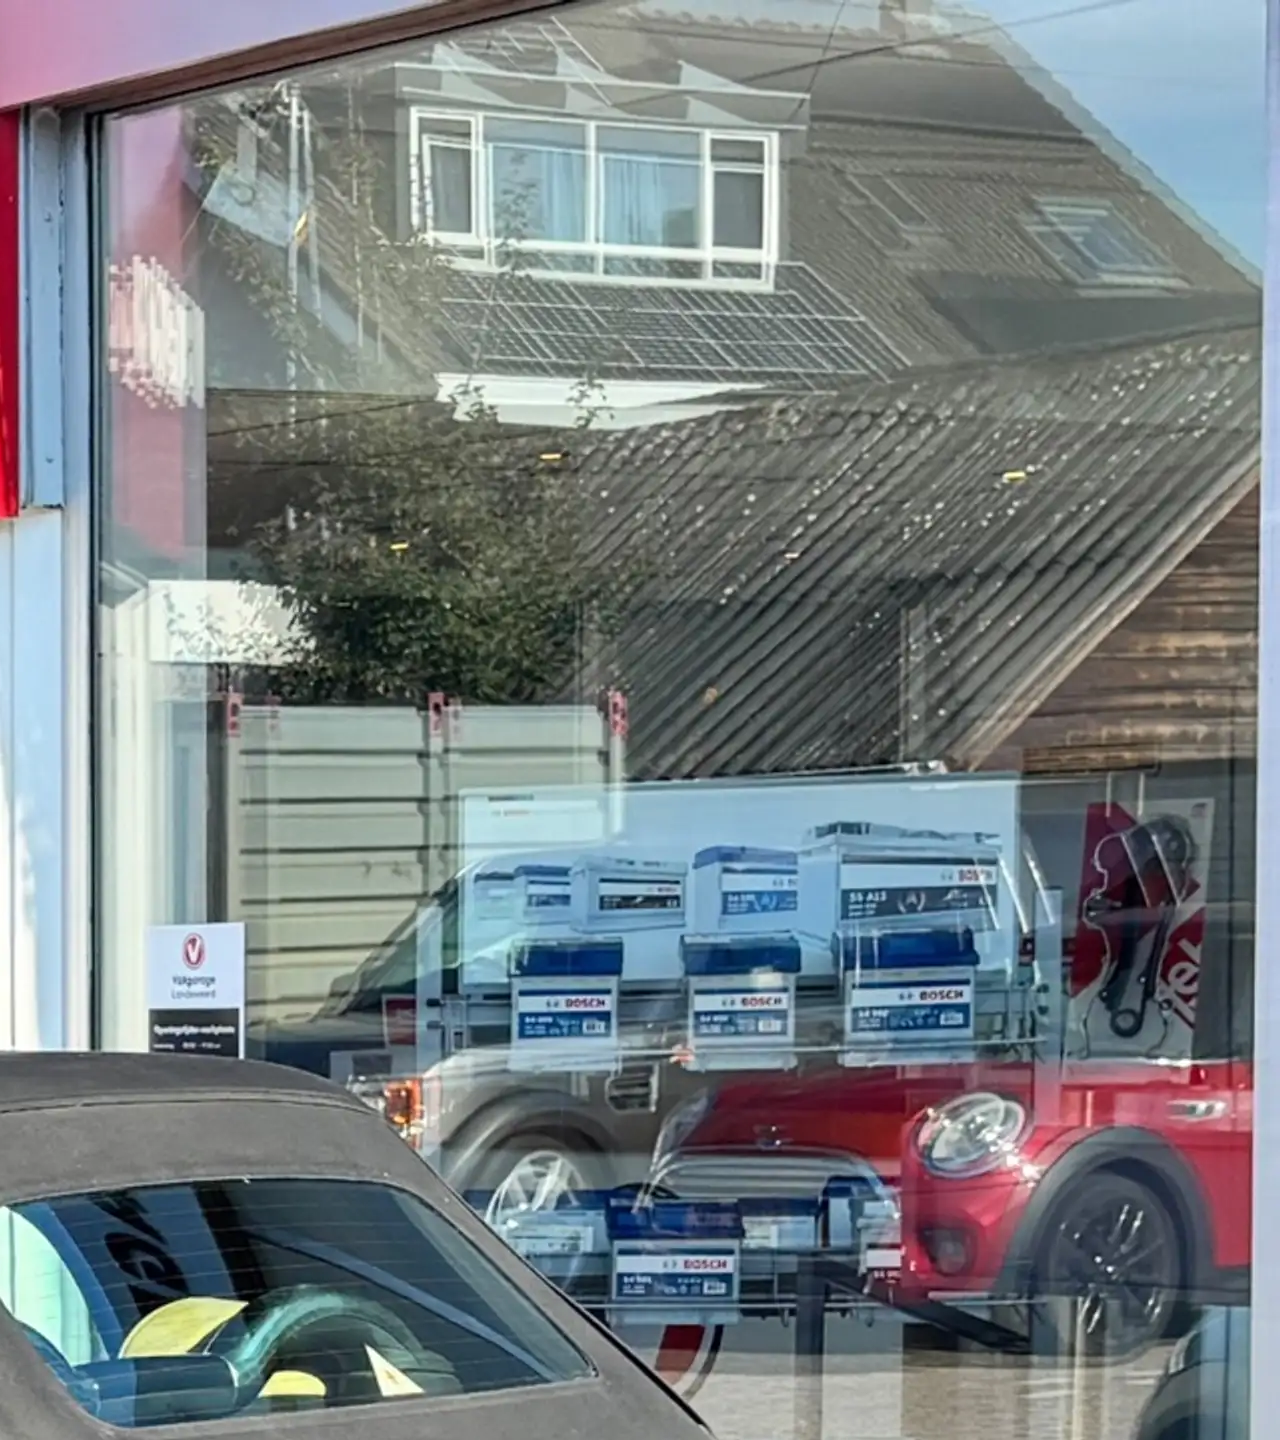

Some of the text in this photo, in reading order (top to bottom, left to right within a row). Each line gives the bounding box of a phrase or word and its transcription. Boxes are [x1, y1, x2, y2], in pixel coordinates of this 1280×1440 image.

[919, 989, 964, 1001] BOSCH
[564, 997, 606, 1009] BOSCH
[741, 996, 782, 1007] BOSCH
[683, 1259, 728, 1269] BOSCH
